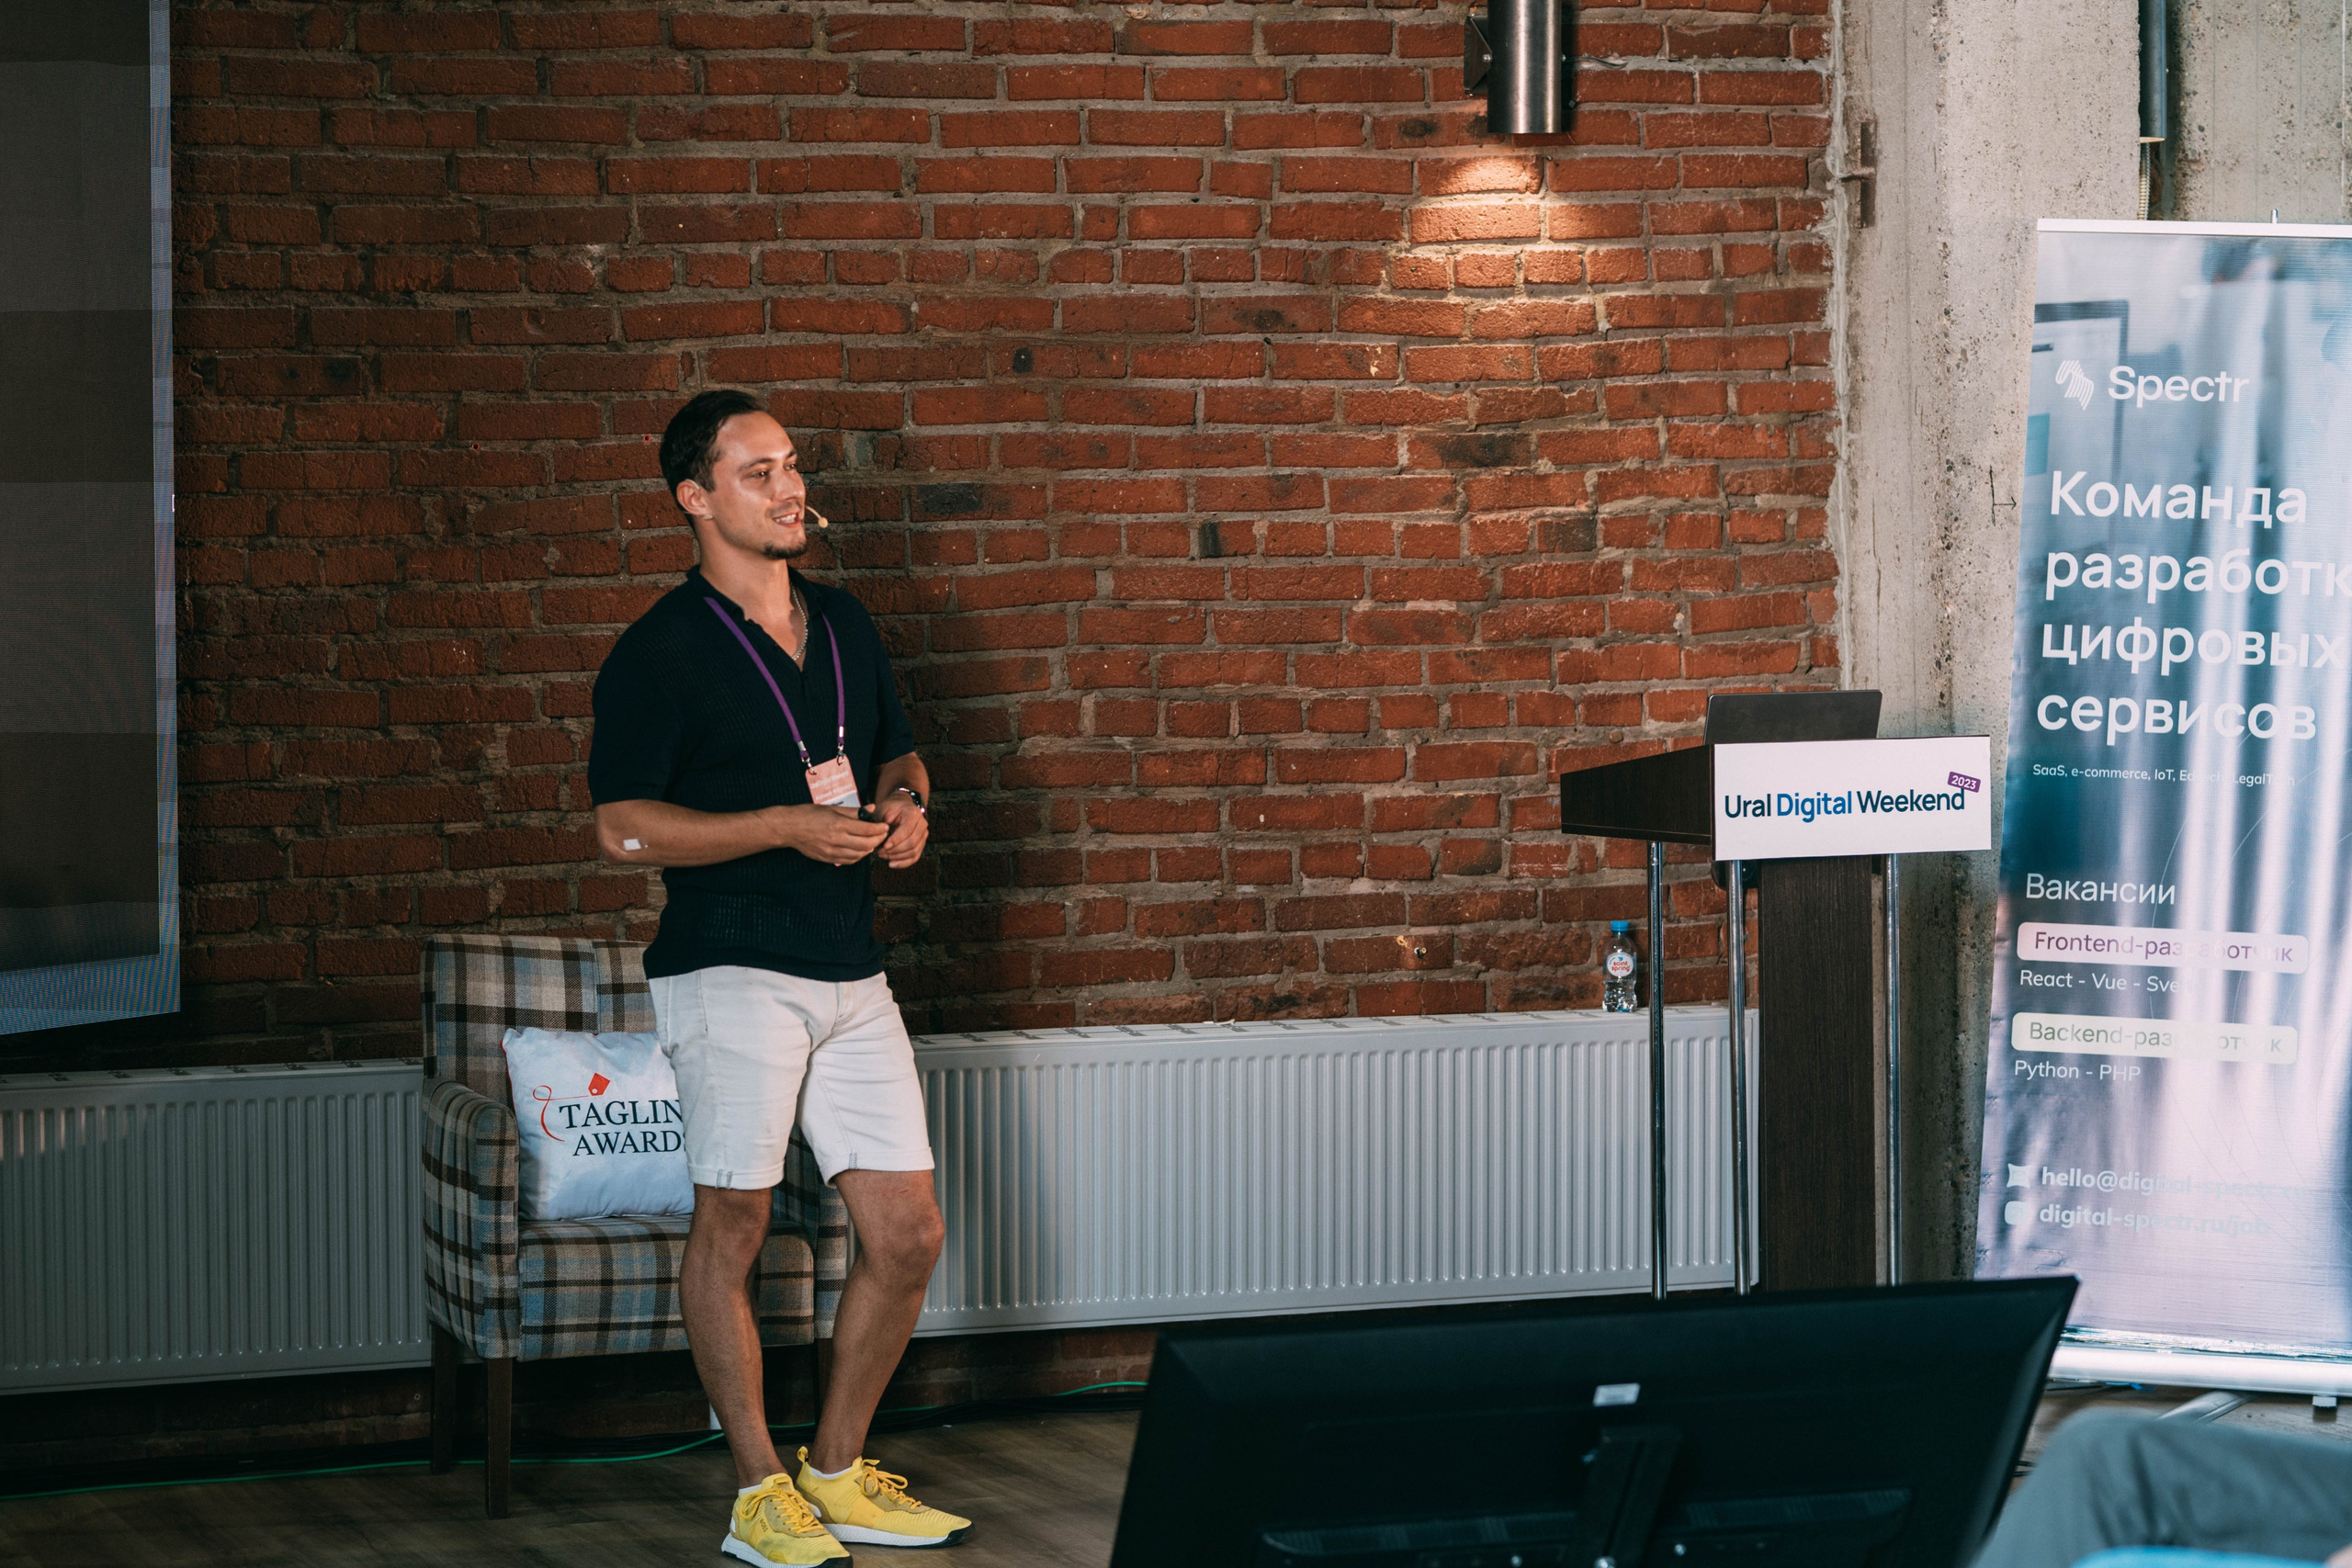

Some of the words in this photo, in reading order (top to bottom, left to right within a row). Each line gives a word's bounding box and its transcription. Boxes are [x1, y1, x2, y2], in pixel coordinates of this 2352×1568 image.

[2108, 366, 2250, 409] Spectr
[2051, 470, 2308, 529] Команда
[2042, 616, 2346, 677] цифровых
[2037, 694, 2316, 747] сервисов
[1951, 774, 1977, 790] 2023
[2032, 763, 2068, 778] SaaS,
[2071, 768, 2151, 781] e-commerce,
[2154, 769, 2176, 782] IoT,
[2179, 769, 2222, 784] Edech
[2232, 773, 2295, 787] LegalTh
[1724, 794, 1771, 818] Ural
[1777, 791, 1852, 823] Digital
[1857, 788, 1965, 814] Weekend
[2026, 873, 2176, 906] Вакансии
[2019, 970, 2073, 987] React
[2091, 973, 2127, 990] Vue
[2015, 1060, 2079, 1080] Python
[2099, 1064, 2142, 1081] PHP
[572, 1130, 686, 1156] AWARD
